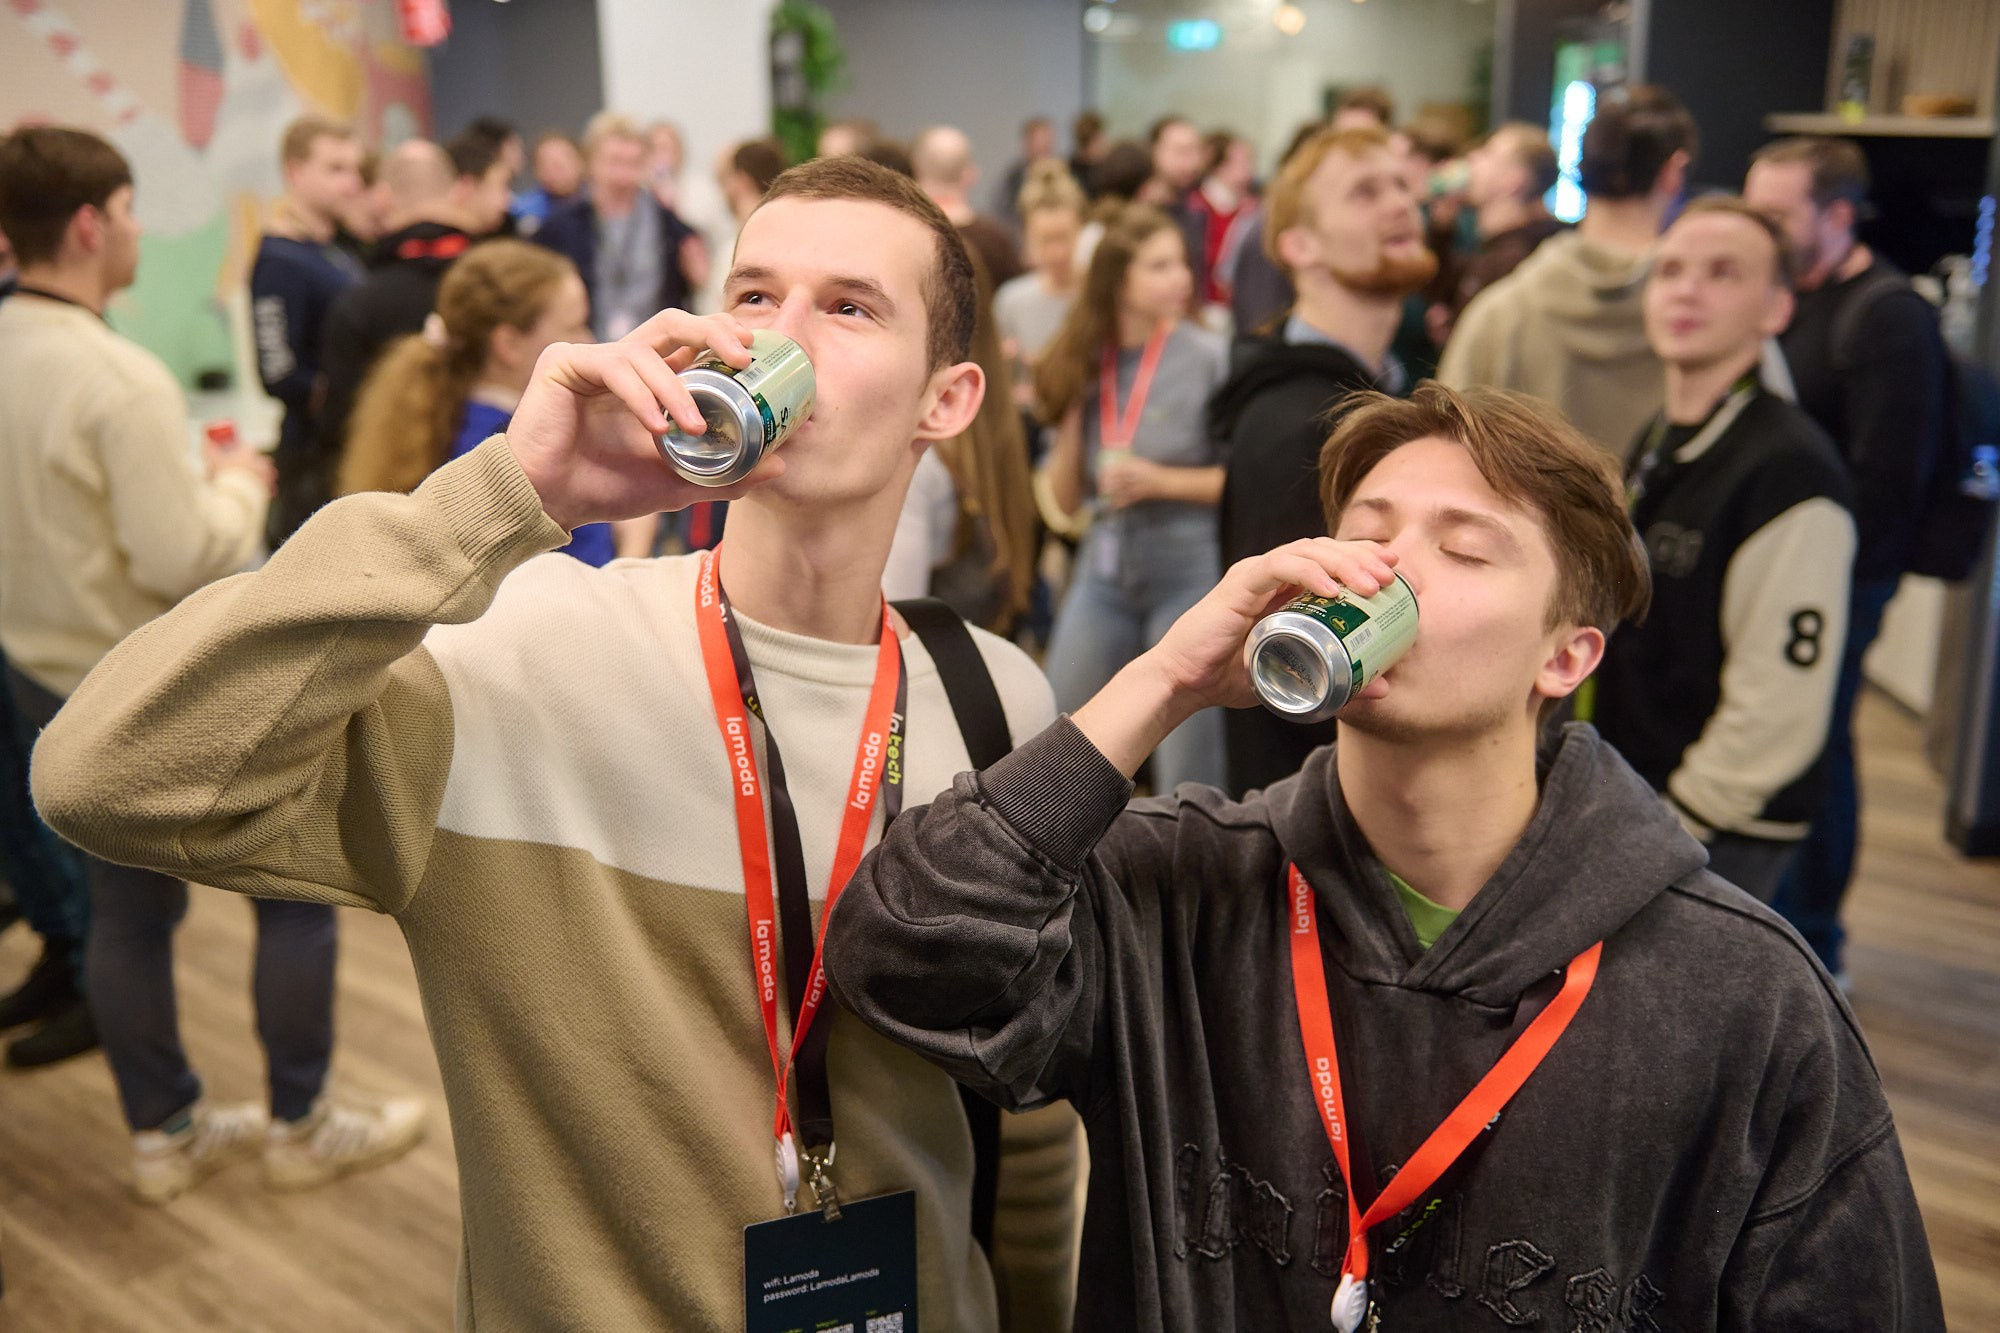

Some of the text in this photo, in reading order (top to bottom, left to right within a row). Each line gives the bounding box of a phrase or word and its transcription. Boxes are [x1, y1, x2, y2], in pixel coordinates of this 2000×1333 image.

[1784, 608, 1824, 668] 8
[726, 716, 755, 796] lamoda
[850, 731, 882, 810] lamoda
[887, 712, 904, 785] latech
[757, 919, 775, 1002] lamoda
[1315, 1056, 1342, 1141] lamoda
[763, 1268, 880, 1304] password: LamodaLamoda
[784, 1269, 820, 1285] Lamoda
